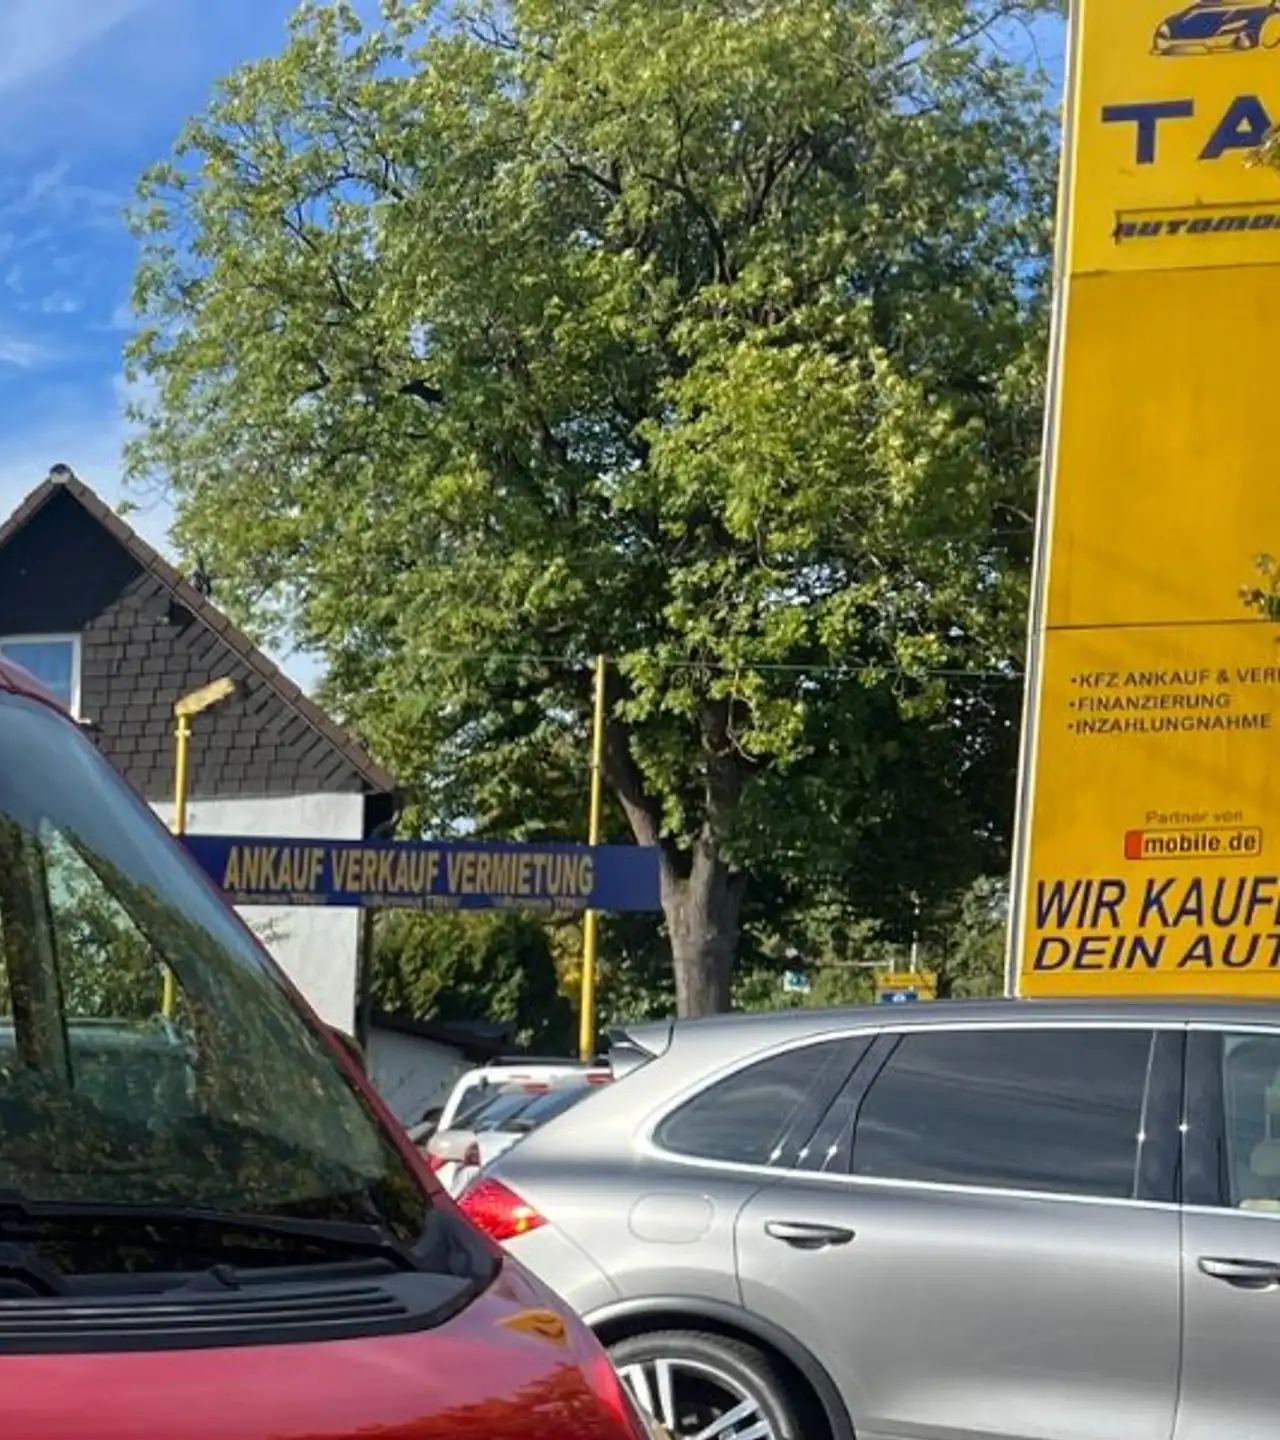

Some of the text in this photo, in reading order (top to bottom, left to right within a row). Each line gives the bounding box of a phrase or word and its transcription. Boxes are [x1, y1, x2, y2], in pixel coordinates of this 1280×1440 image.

[1079, 667, 1280, 689] KFZ ANKAUF & VER
[1076, 692, 1232, 712] FINANZIERUNG
[1075, 713, 1272, 735] INZAHLUNGNAHME
[1144, 810, 1244, 825] Partner von
[1144, 832, 1258, 854] mobile.de
[223, 846, 595, 896] ANKAUF VERKAUF VERMIETUNG
[1036, 876, 1280, 930] WIR KAUF
[1033, 934, 1167, 972] DEIN
